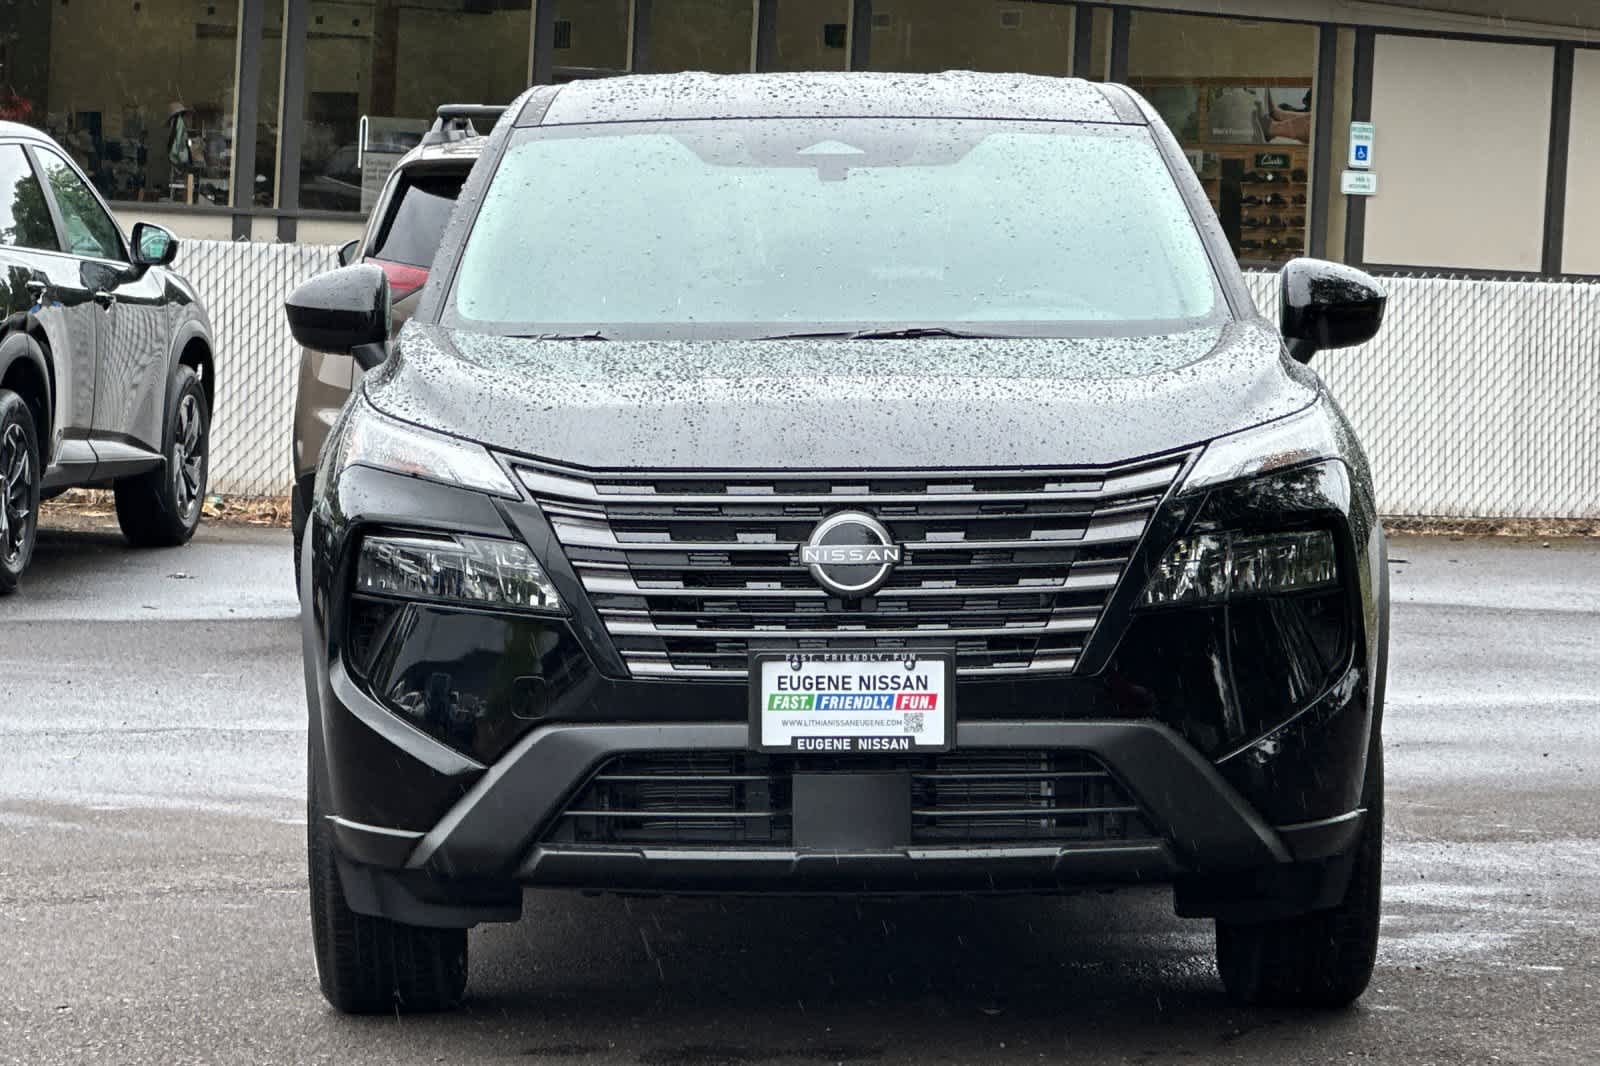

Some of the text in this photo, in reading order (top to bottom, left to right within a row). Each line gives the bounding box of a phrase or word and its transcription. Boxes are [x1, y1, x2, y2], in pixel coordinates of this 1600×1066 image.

[804, 549, 899, 561] NISSAN
[777, 675, 928, 690] EUGENE NISSAN
[772, 696, 933, 709] FAST. FRIENDLY. FUN.
[781, 719, 902, 727] WWW.LITHIANISSANEUGENE.COM
[797, 739, 911, 750] EUGENE NISSAN
